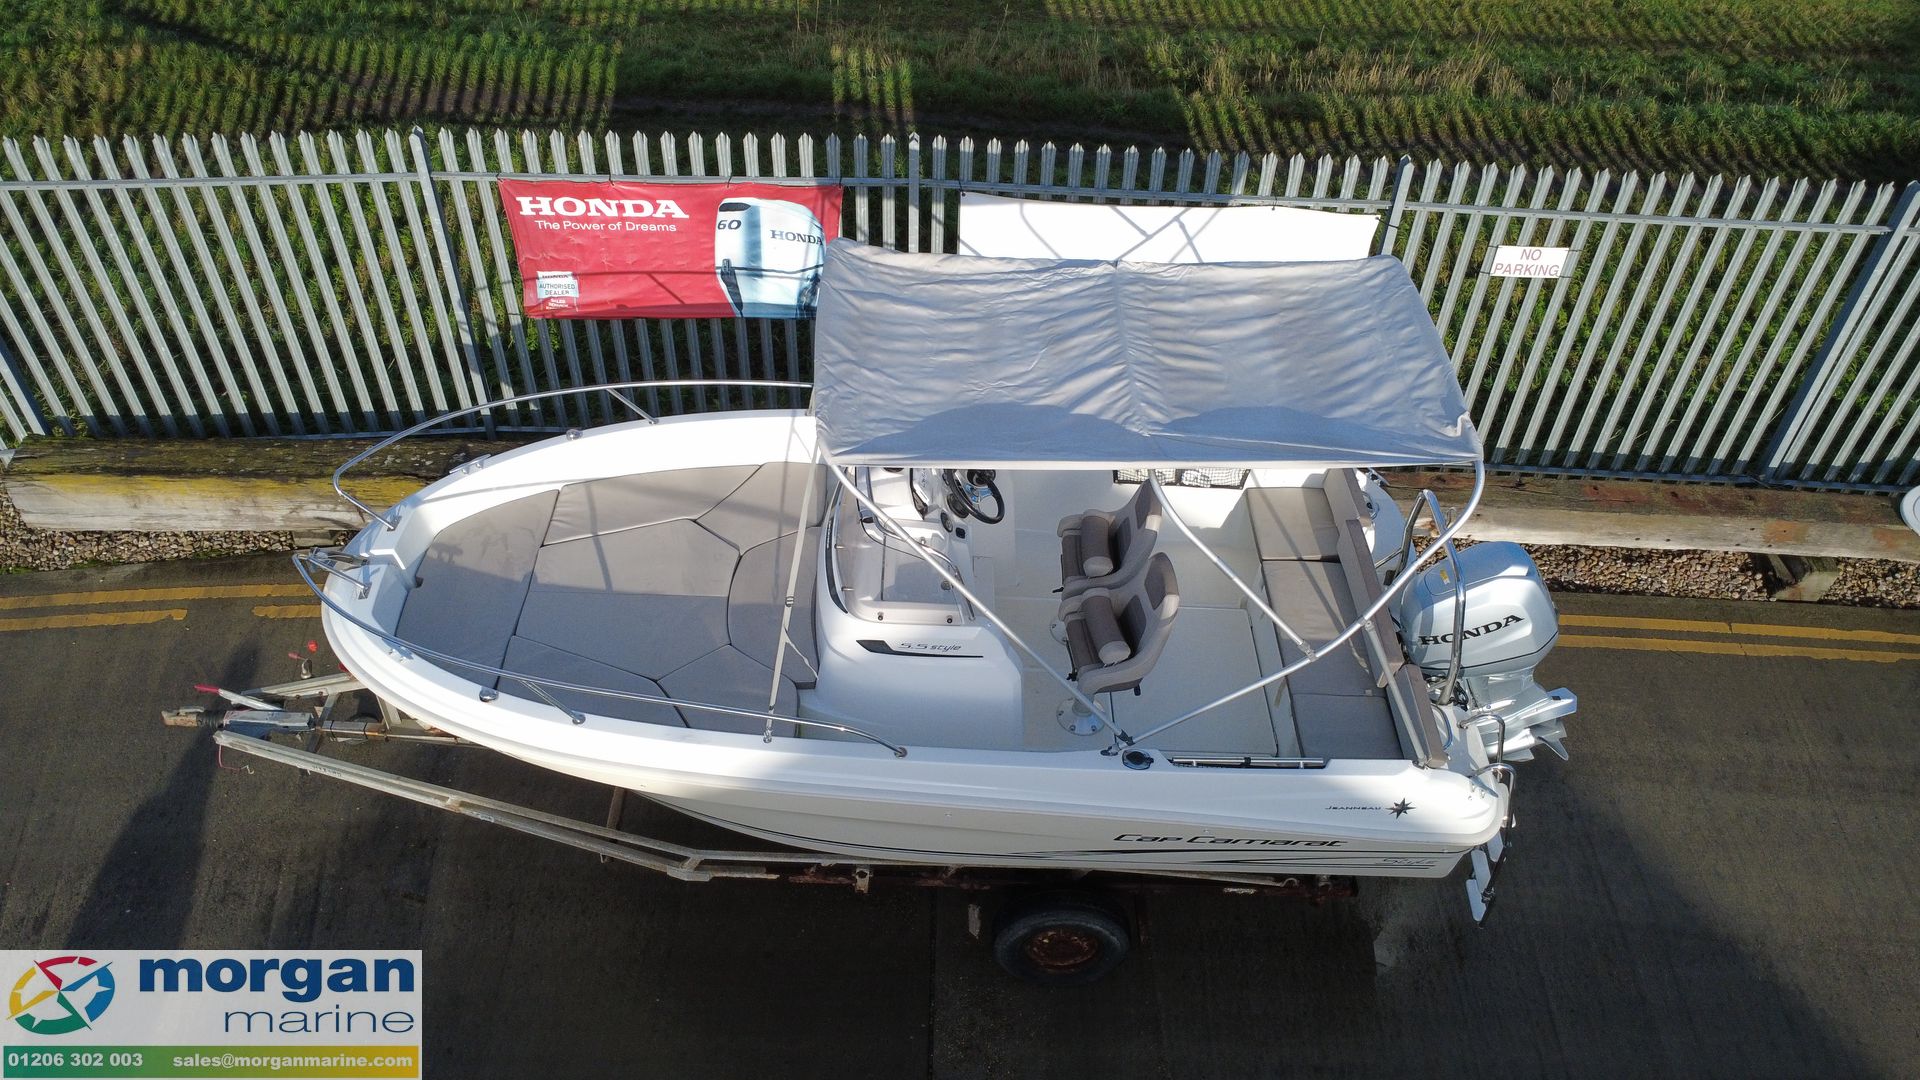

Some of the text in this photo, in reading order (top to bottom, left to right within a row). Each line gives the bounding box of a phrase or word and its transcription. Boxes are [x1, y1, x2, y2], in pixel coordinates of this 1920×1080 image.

[516, 196, 689, 218] HONDA
[534, 220, 676, 232] The Power of Dreams
[717, 219, 742, 230] 60
[770, 230, 823, 246] HONDA
[1519, 248, 1542, 261] NO
[1493, 263, 1560, 277] PARKING
